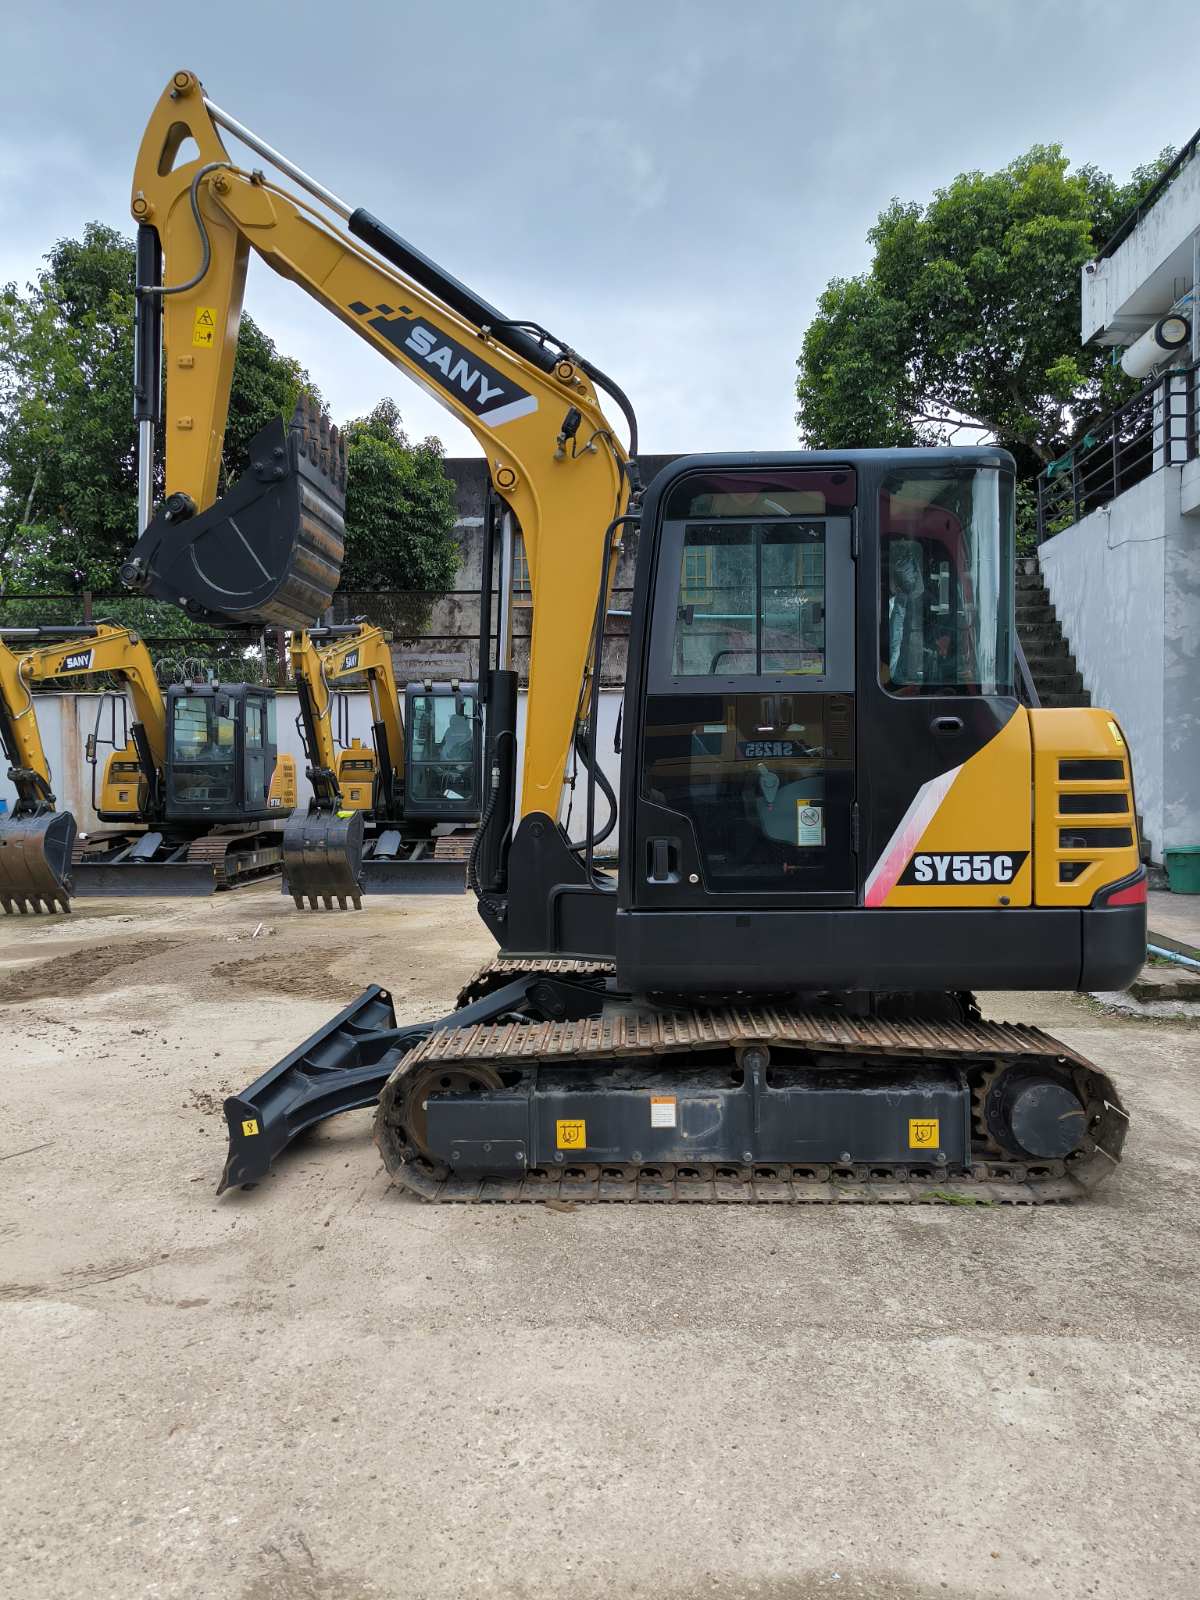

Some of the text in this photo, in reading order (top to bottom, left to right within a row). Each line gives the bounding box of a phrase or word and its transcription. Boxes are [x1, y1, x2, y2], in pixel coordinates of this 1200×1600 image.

[405, 326, 505, 405] SANY
[66, 655, 89, 669] SANY
[914, 855, 1013, 882] SY55C
